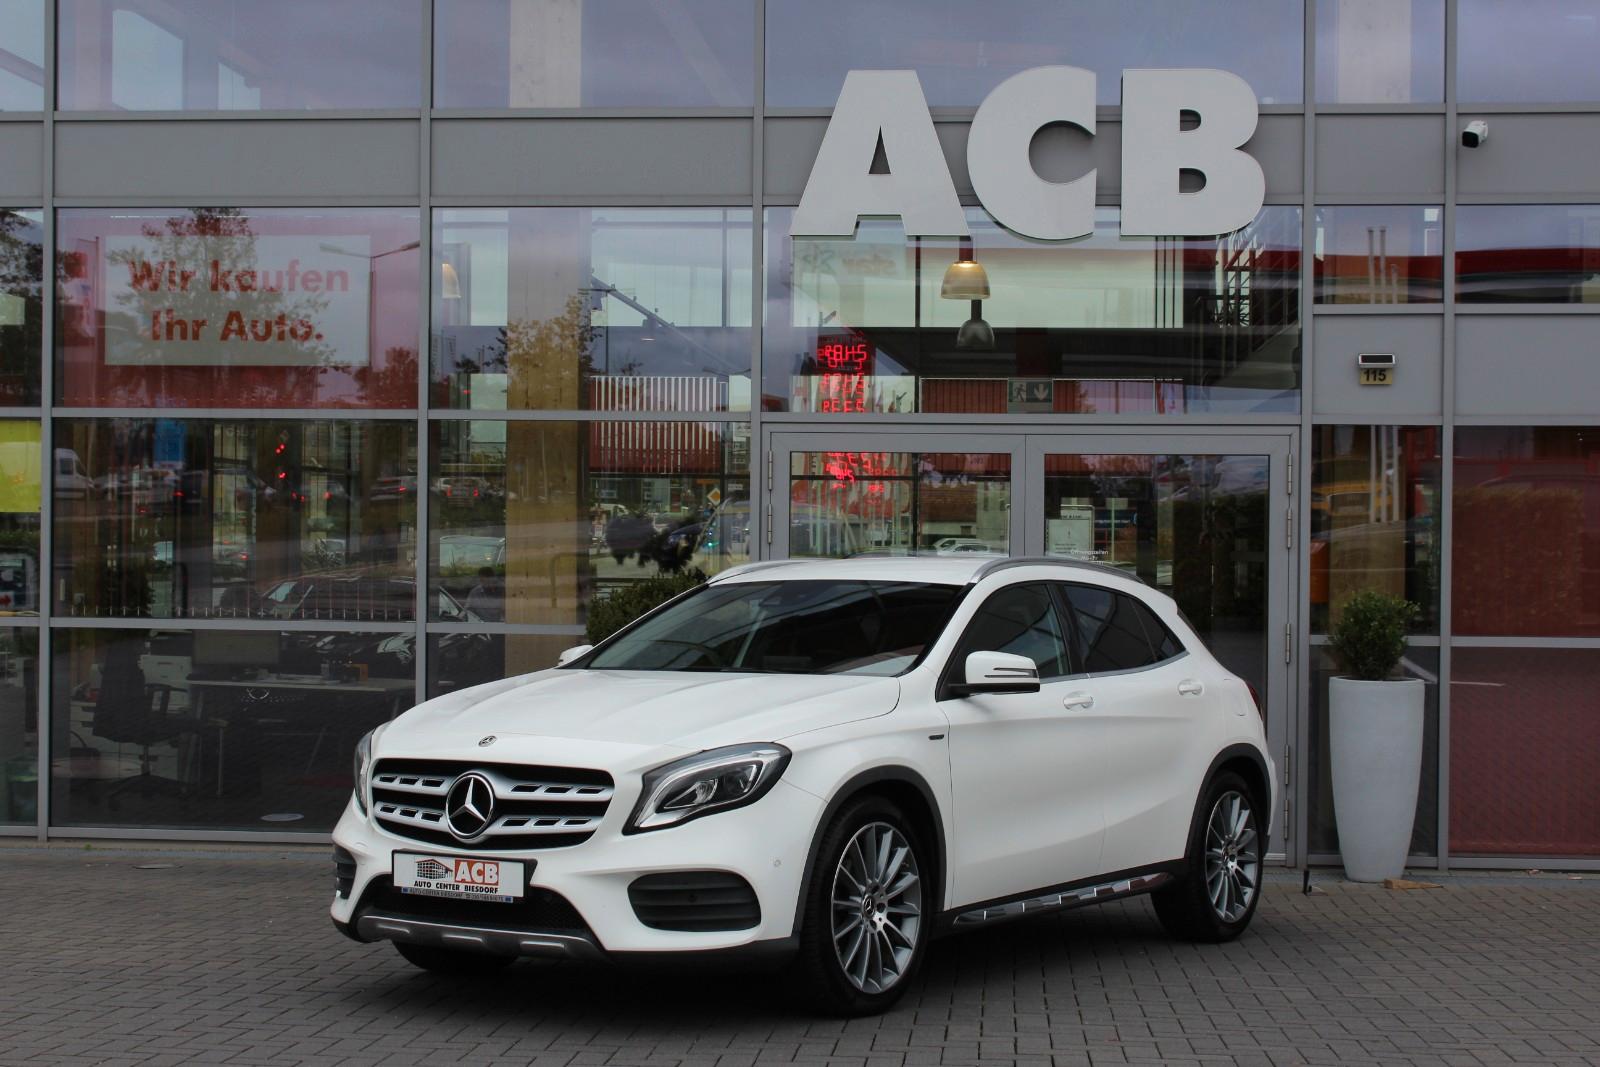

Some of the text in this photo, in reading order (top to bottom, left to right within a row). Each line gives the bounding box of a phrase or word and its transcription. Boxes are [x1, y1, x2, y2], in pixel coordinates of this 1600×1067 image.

[790, 65, 1266, 240] ACB
[128, 258, 350, 293] Wir kaufen
[151, 309, 324, 343] Ihr Auto.
[1363, 369, 1387, 382] 115
[455, 860, 498, 885] ACB
[414, 880, 499, 895] AUTO CENTER BIESDORF
